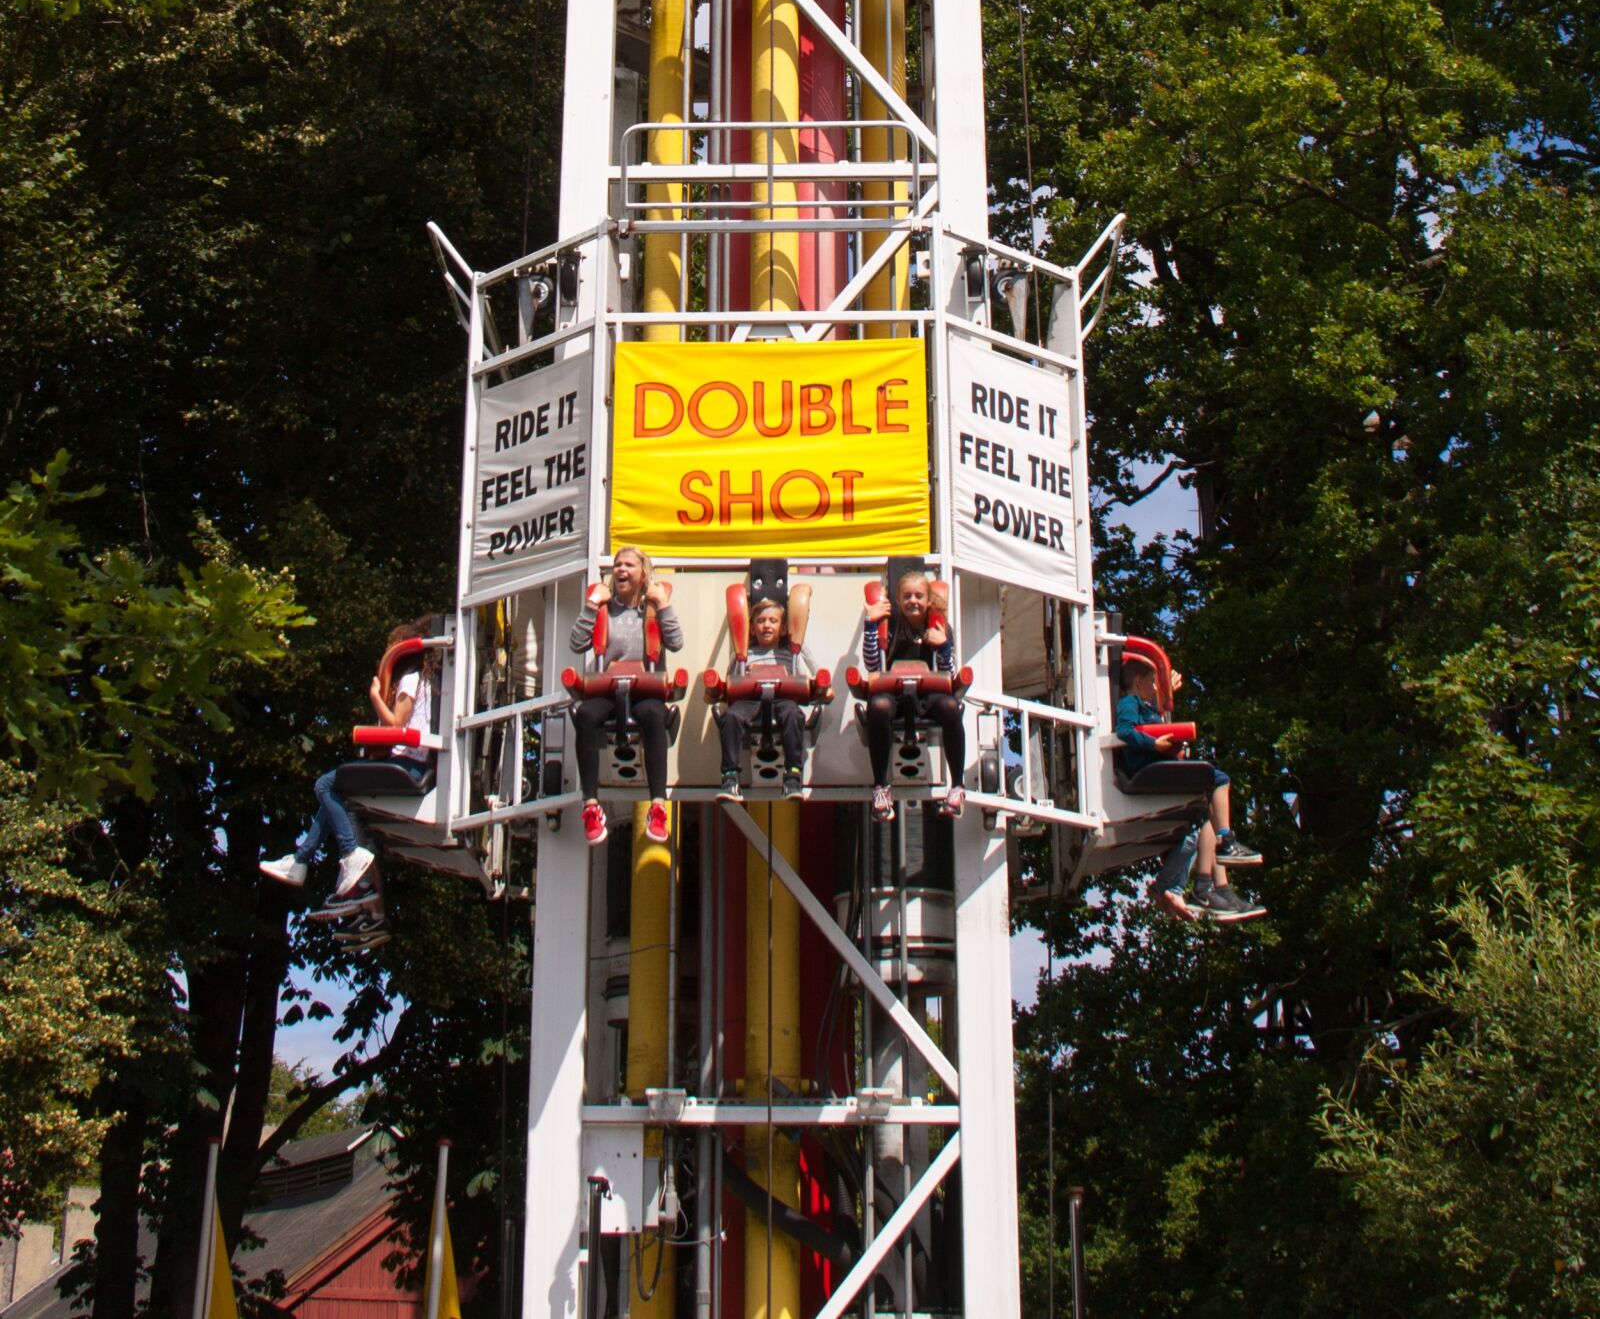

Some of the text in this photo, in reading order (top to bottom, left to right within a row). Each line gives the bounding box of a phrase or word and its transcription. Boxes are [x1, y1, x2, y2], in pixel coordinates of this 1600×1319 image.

[495, 391, 577, 453] RIDE IT
[634, 378, 909, 438] DOUBLE
[971, 382, 1057, 439] RIDE IT
[481, 443, 586, 512] FEEL THE
[960, 432, 1072, 499] FEEL THE
[677, 469, 864, 526] SHOT
[974, 493, 1065, 551] POWER
[487, 506, 575, 560] POWER
